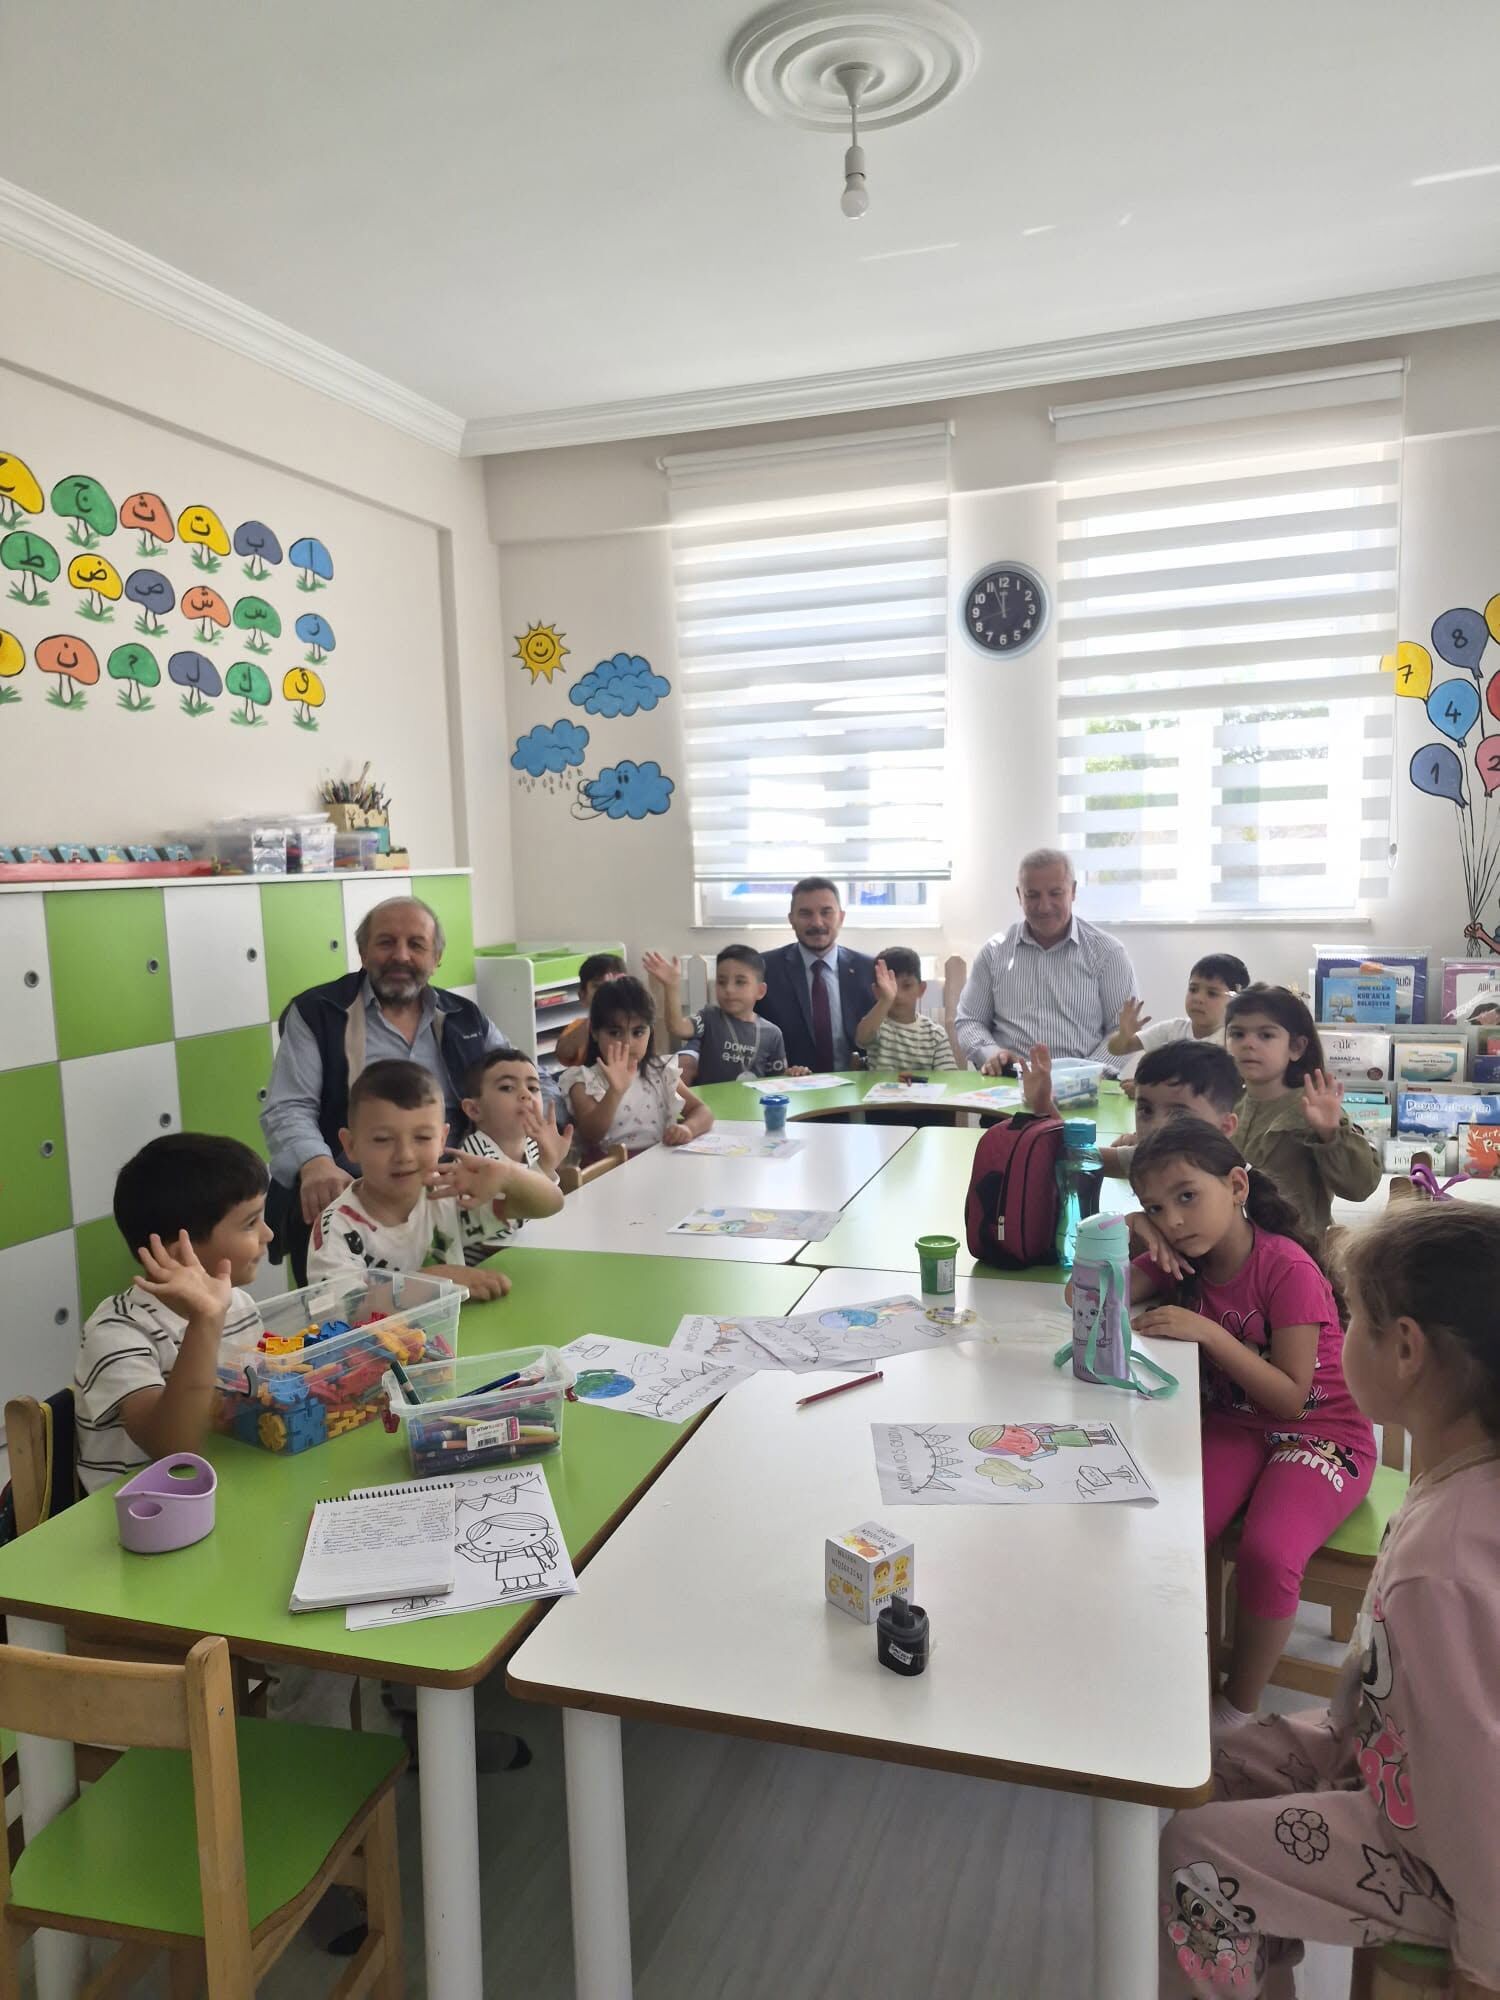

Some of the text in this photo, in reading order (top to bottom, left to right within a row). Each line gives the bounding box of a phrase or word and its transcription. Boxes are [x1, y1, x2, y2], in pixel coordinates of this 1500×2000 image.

[73, 482, 91, 513] ج
[132, 495, 156, 522] ث
[190, 515, 211, 537] ت
[20, 535, 45, 568] ط
[245, 536, 265, 553] ب
[76, 560, 108, 583] ض
[134, 581, 165, 595] ص
[986, 581, 995, 593] 11
[999, 577, 1010, 588] 12
[190, 588, 214, 610] ش
[975, 594, 986, 605] 10
[1025, 590, 1033, 601] 2
[244, 608, 267, 619] س
[972, 607, 980, 618] 9
[1028, 604, 1036, 615] 3
[975, 622, 983, 633] 8
[1023, 619, 1031, 630] 4
[985, 631, 994, 642] 7
[1000, 634, 1007, 645] 6
[1013, 630, 1021, 641] 5
[1451, 628, 1468, 649] 8
[57, 642, 79, 668] ن
[186, 656, 200, 683] ل
[1397, 663, 1414, 684] 7
[1444, 701, 1462, 724] 4
[1487, 755, 1500, 771] 2
[1430, 762, 1440, 784] 1
[1471, 1129, 1500, 1142] Kart
